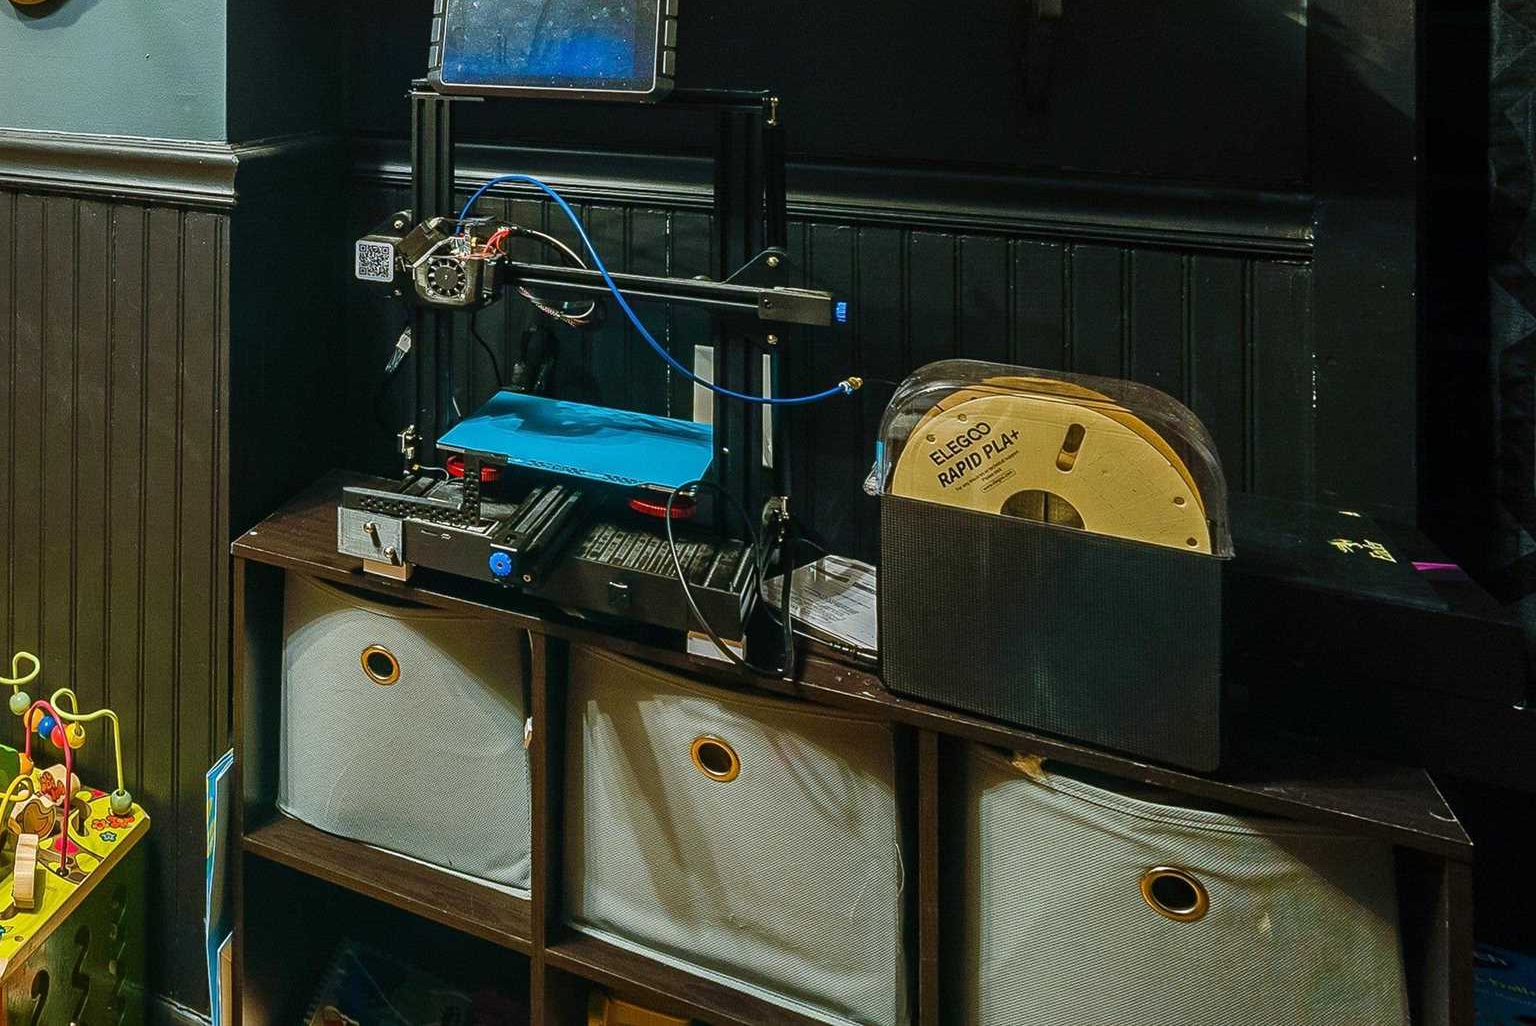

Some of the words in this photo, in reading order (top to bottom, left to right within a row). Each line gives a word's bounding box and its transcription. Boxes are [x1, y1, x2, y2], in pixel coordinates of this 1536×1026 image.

[929, 422, 992, 466] ELEGOO
[937, 452, 983, 488] RAPID
[982, 430, 1020, 460] PLA+
